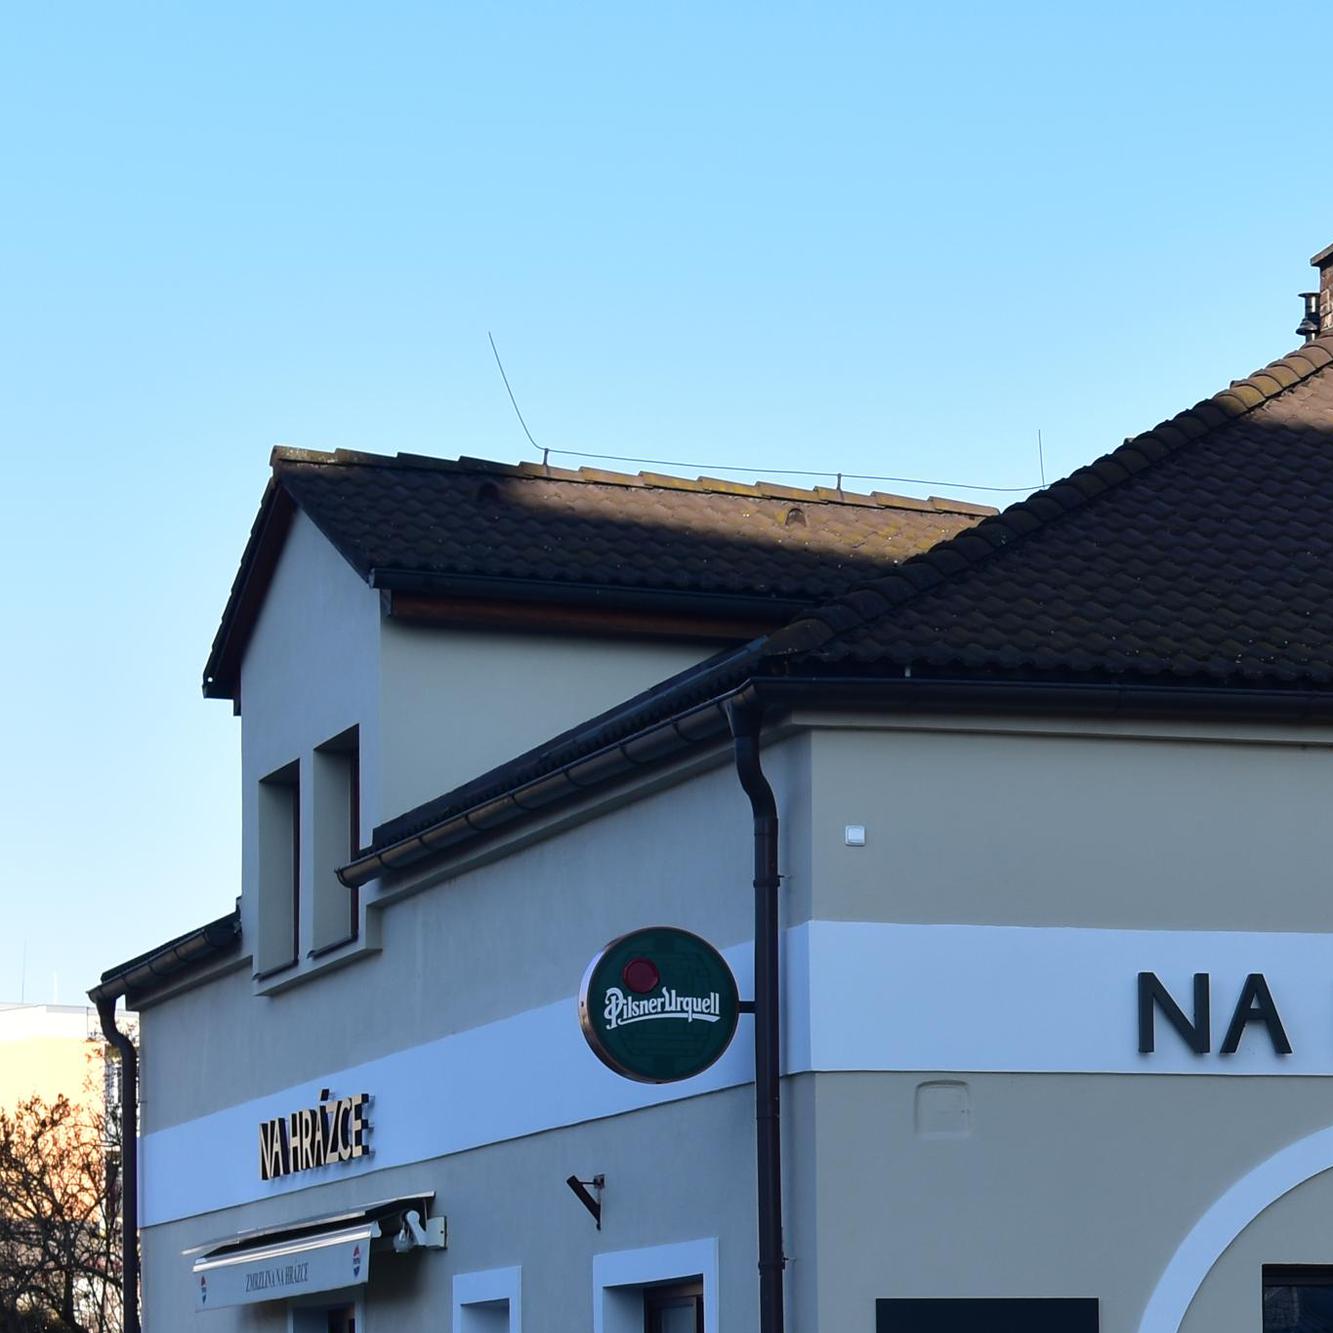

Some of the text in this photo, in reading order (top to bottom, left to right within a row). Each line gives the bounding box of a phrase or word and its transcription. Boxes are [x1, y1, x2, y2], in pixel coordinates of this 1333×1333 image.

[603, 986, 720, 1030] Pilsner Urquell
[1137, 971, 1293, 1055] NA
[260, 1088, 369, 1180] NA HRÁZCE
